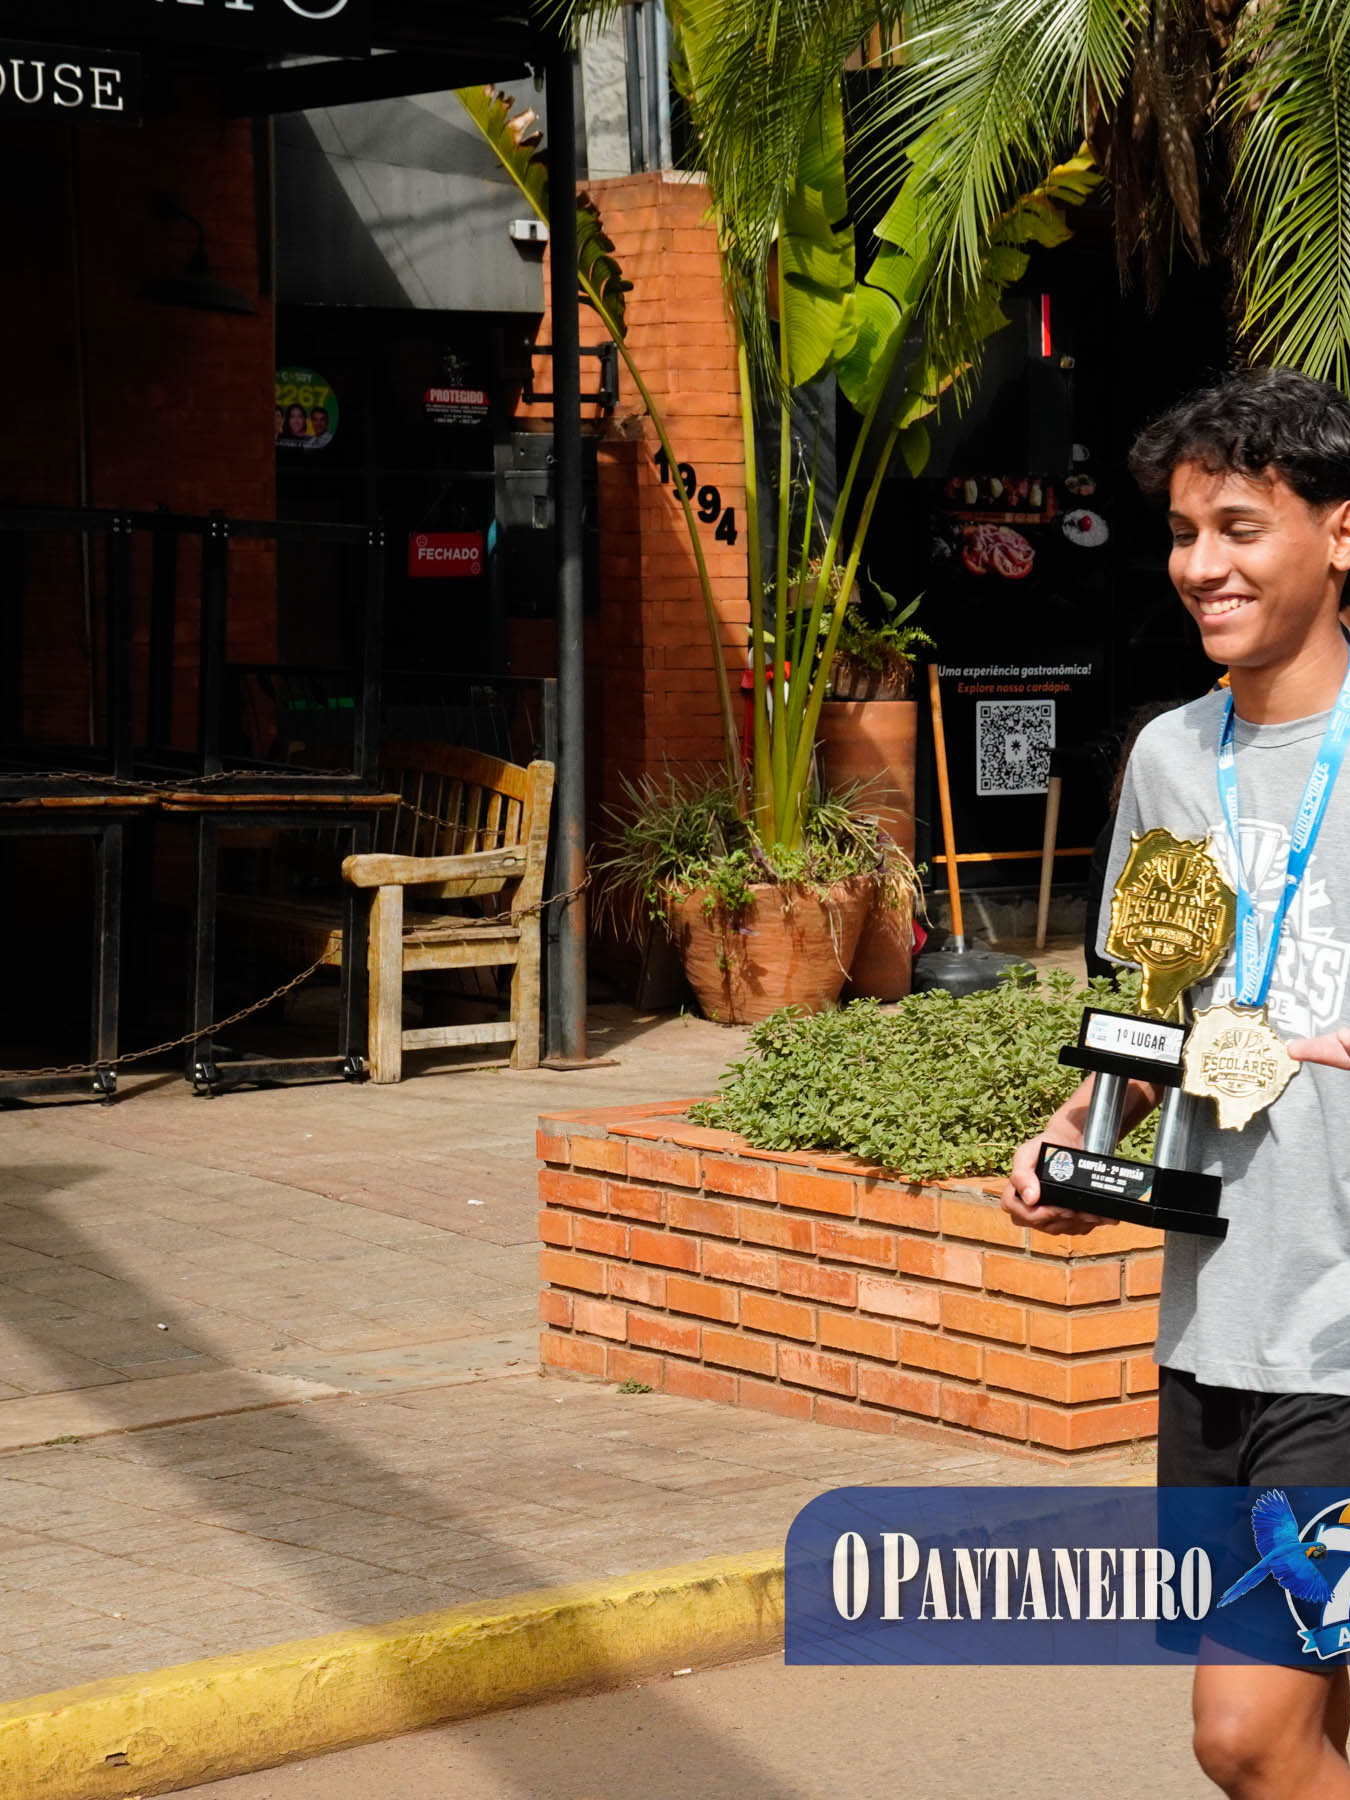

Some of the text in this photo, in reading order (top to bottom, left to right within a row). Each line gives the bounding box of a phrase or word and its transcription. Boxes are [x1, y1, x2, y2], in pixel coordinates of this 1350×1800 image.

[0, 57, 125, 112] USE
[429, 387, 485, 405] PROTEGIDO
[654, 444, 738, 546] 1994
[417, 547, 480, 561] FECHADO
[938, 663, 1093, 679] Uma experiência gastronômica!
[957, 681, 1073, 695] Explore nosso cardápio.
[1291, 762, 1330, 854] FUNDESPORTE
[1122, 893, 1218, 939] ESCOLARES
[1131, 1031, 1167, 1051] LUGAR
[1202, 1055, 1276, 1080] ESCOLARES
